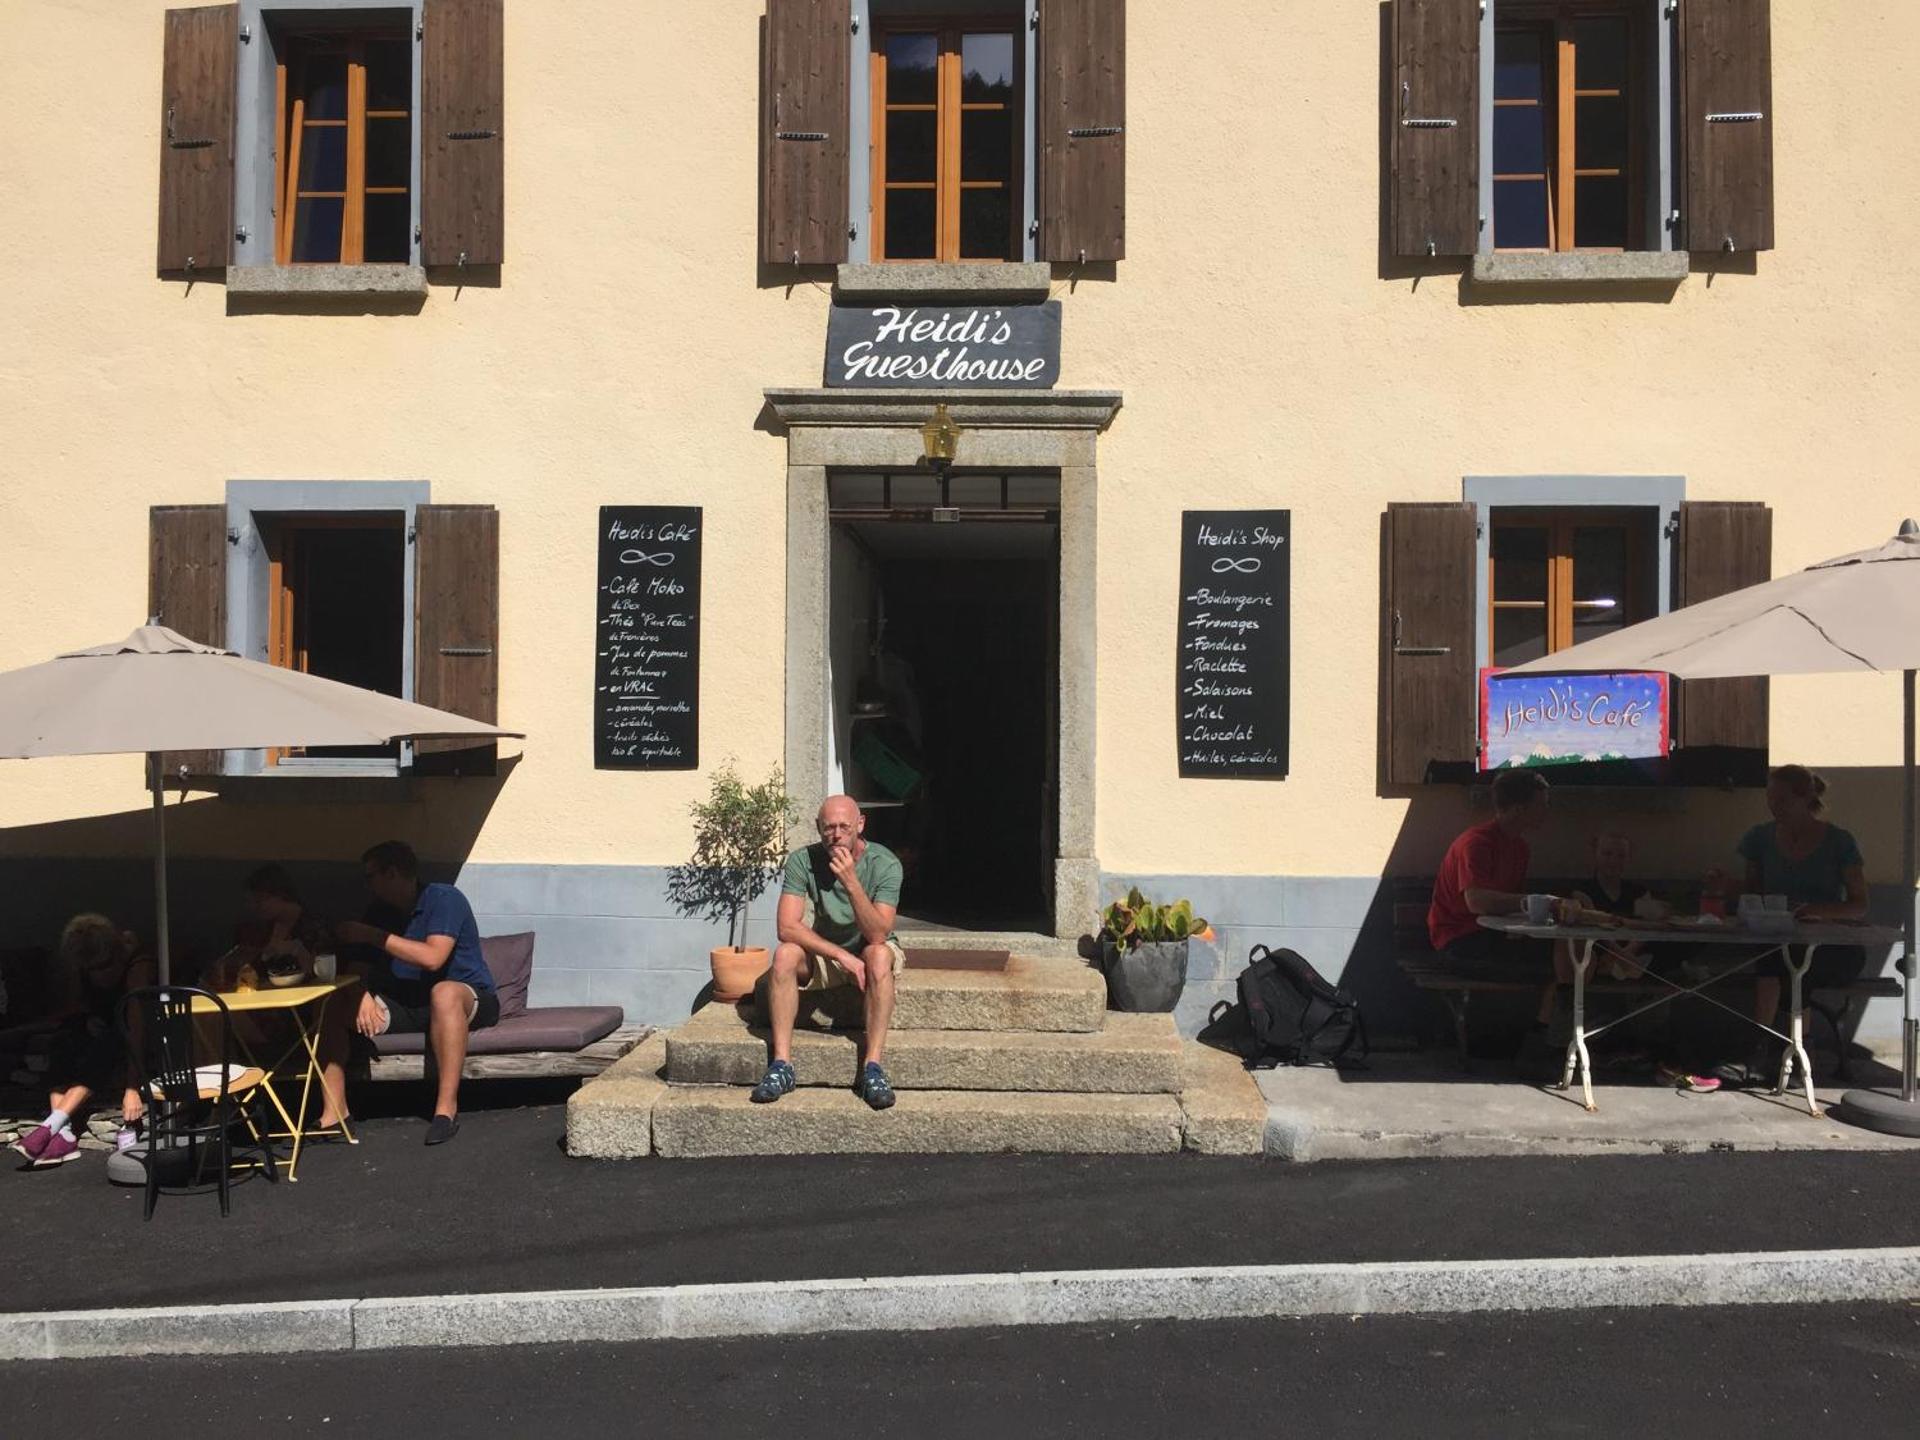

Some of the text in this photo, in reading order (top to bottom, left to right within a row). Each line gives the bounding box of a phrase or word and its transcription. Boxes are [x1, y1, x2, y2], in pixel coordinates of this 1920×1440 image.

[872, 308, 1011, 345] Heidi's
[843, 341, 1046, 381] Guesthouse
[658, 523, 697, 542] Café
[1197, 524, 1285, 551] Heidi's Shop
[646, 576, 685, 596] Moko
[633, 646, 646, 658] de
[646, 650, 688, 664] pommes
[610, 666, 620, 676] de
[624, 680, 655, 693] VRAC
[1504, 685, 1652, 738] Heidi's Café
